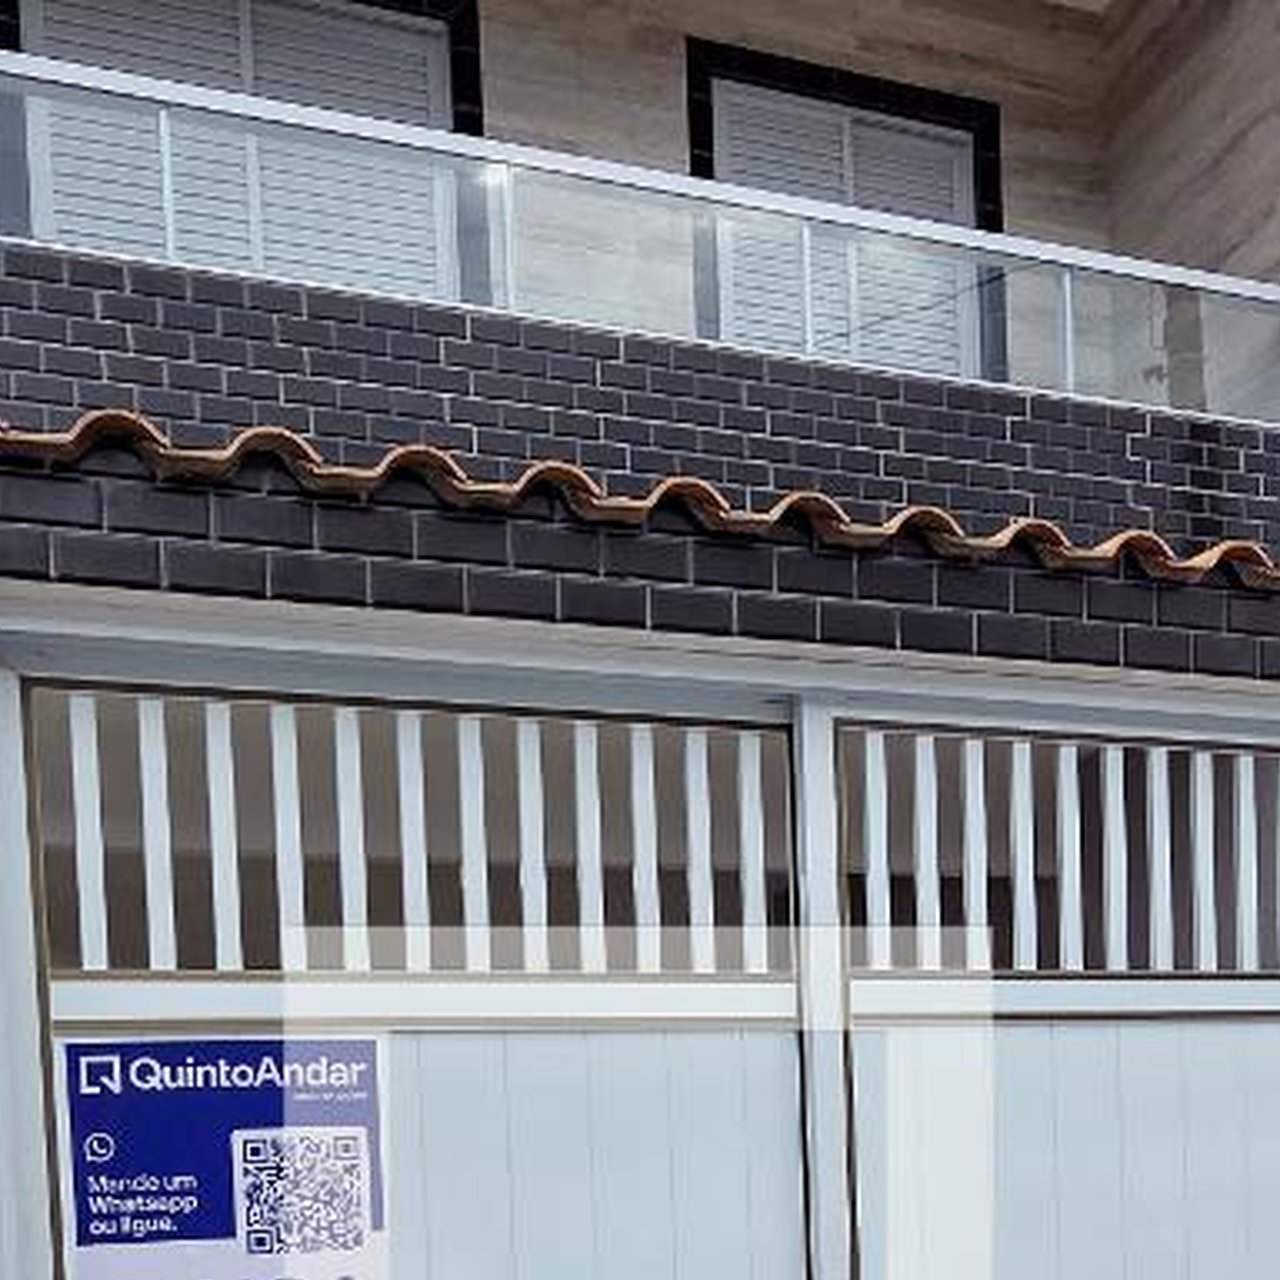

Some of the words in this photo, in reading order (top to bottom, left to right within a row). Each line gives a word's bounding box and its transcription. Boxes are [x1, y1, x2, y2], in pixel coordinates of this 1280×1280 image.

[129, 1055, 368, 1091] QuintoAndar
[163, 1175, 198, 1192] um
[89, 1219, 117, 1235] ou
